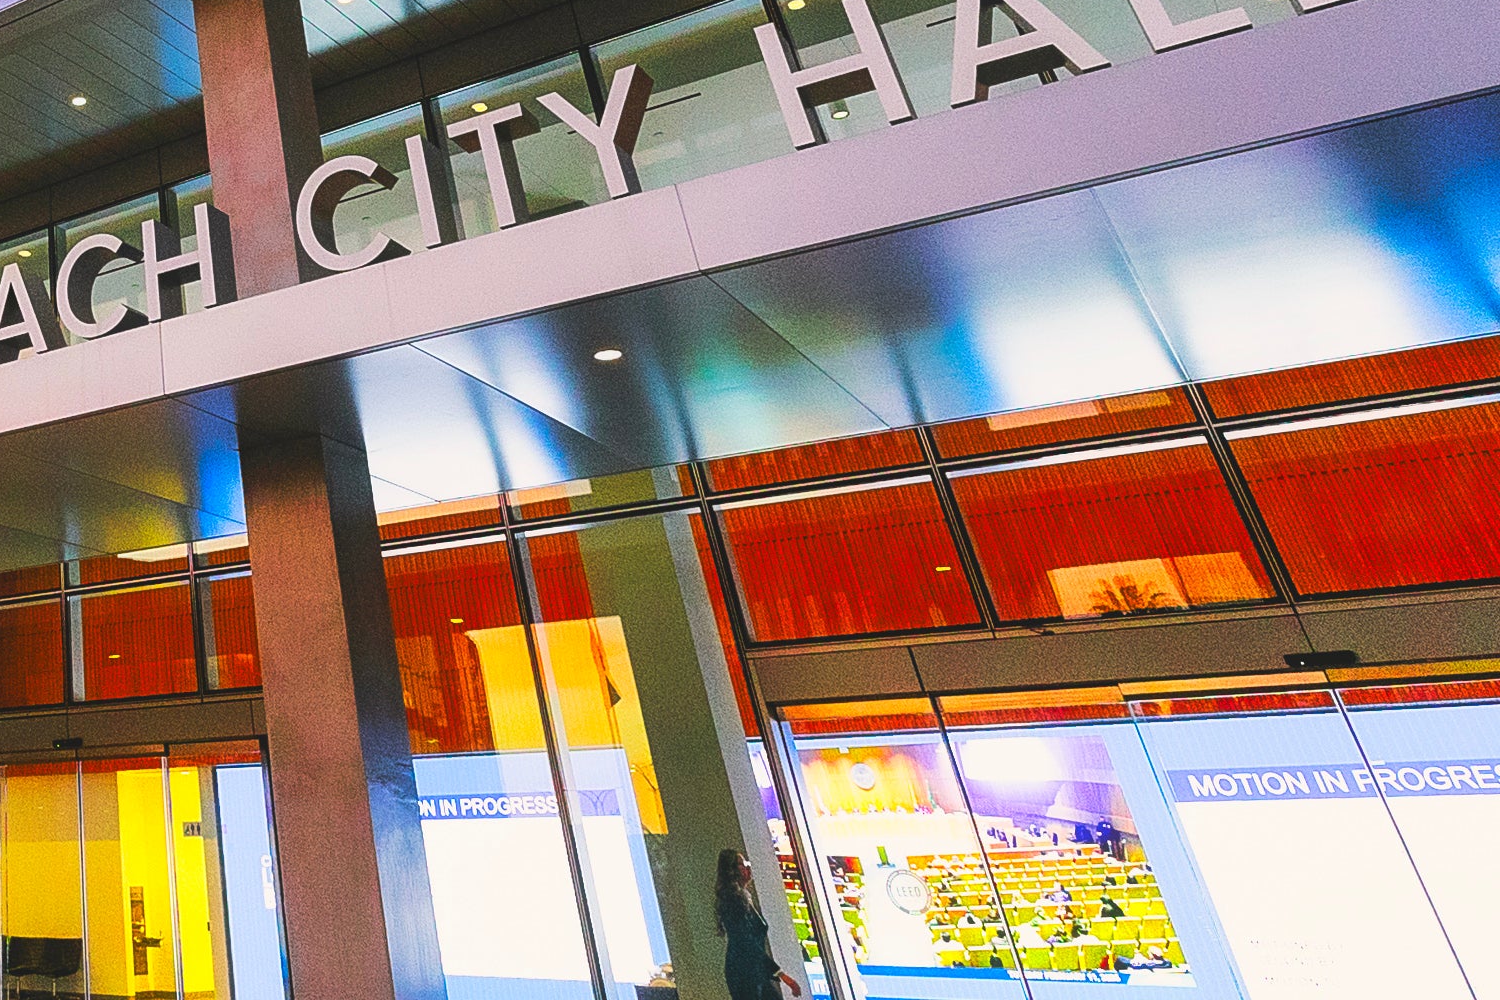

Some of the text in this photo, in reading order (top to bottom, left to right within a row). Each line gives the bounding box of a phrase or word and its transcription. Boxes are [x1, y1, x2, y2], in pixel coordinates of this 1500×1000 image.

[296, 64, 646, 272] CITY
[1187, 773, 1310, 797] MOTION
[1312, 769, 1350, 794] IN
[439, 798, 458, 817] IN
[460, 796, 557, 815] PROGRESS
